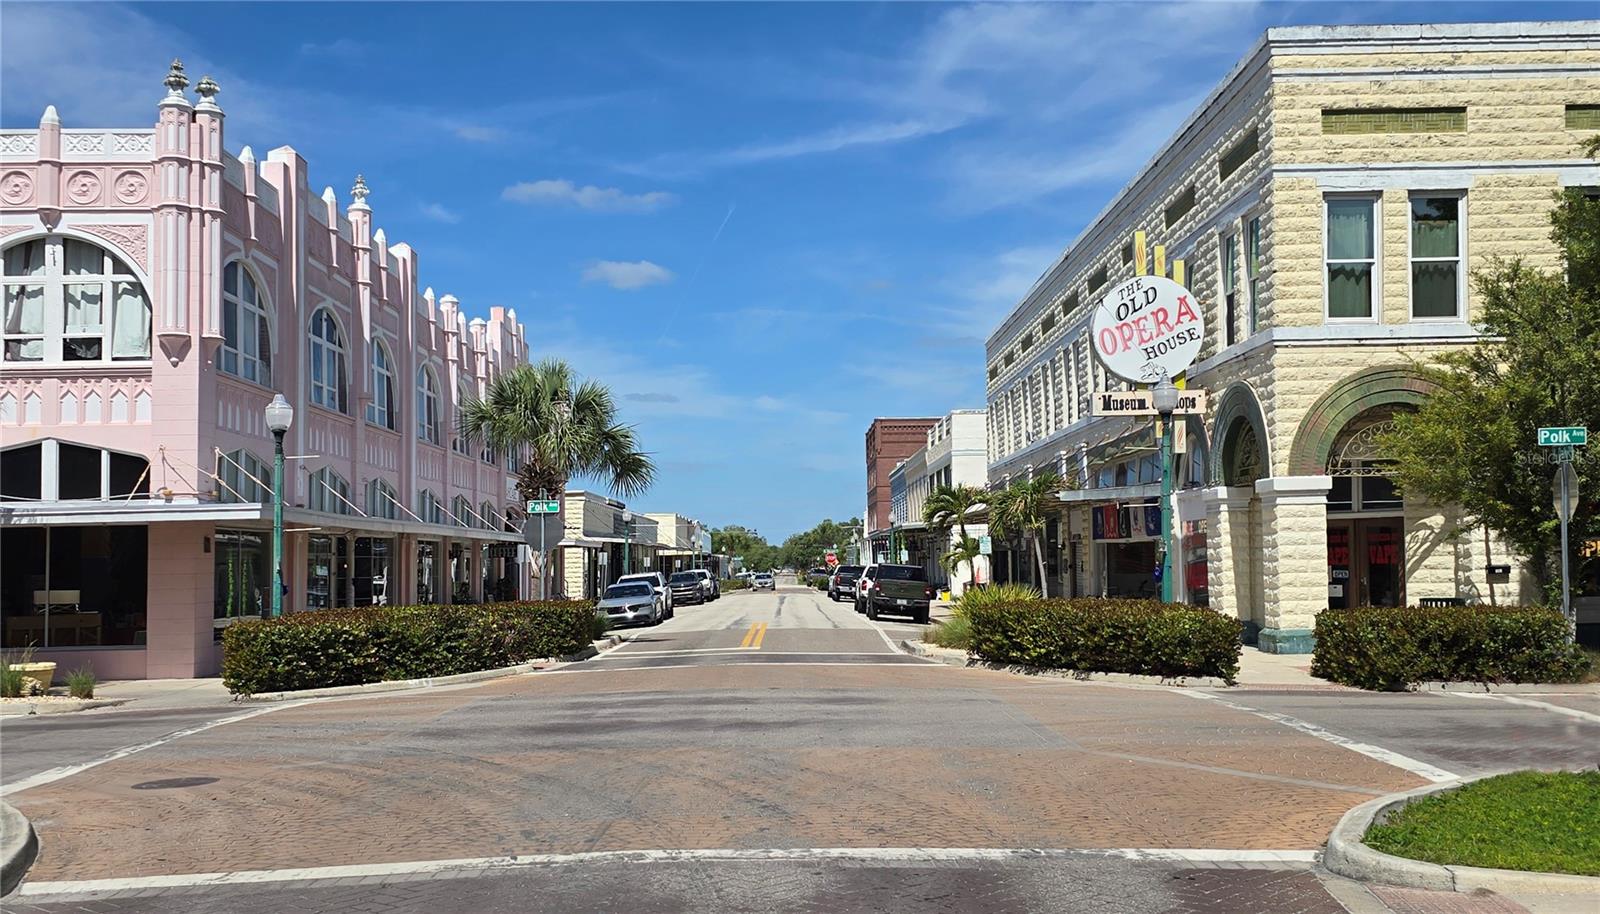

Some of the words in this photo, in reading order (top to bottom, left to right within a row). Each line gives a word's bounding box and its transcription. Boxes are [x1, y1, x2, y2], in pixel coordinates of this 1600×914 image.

[1117, 278, 1143, 301] THE
[1116, 286, 1158, 322] OLD
[1099, 295, 1198, 356] OPERA
[1142, 327, 1201, 361] HOUSE
[1101, 394, 1149, 411] Museum
[1540, 429, 1572, 443] Polk
[1572, 429, 1585, 437] Ave
[528, 502, 548, 511] Polk
